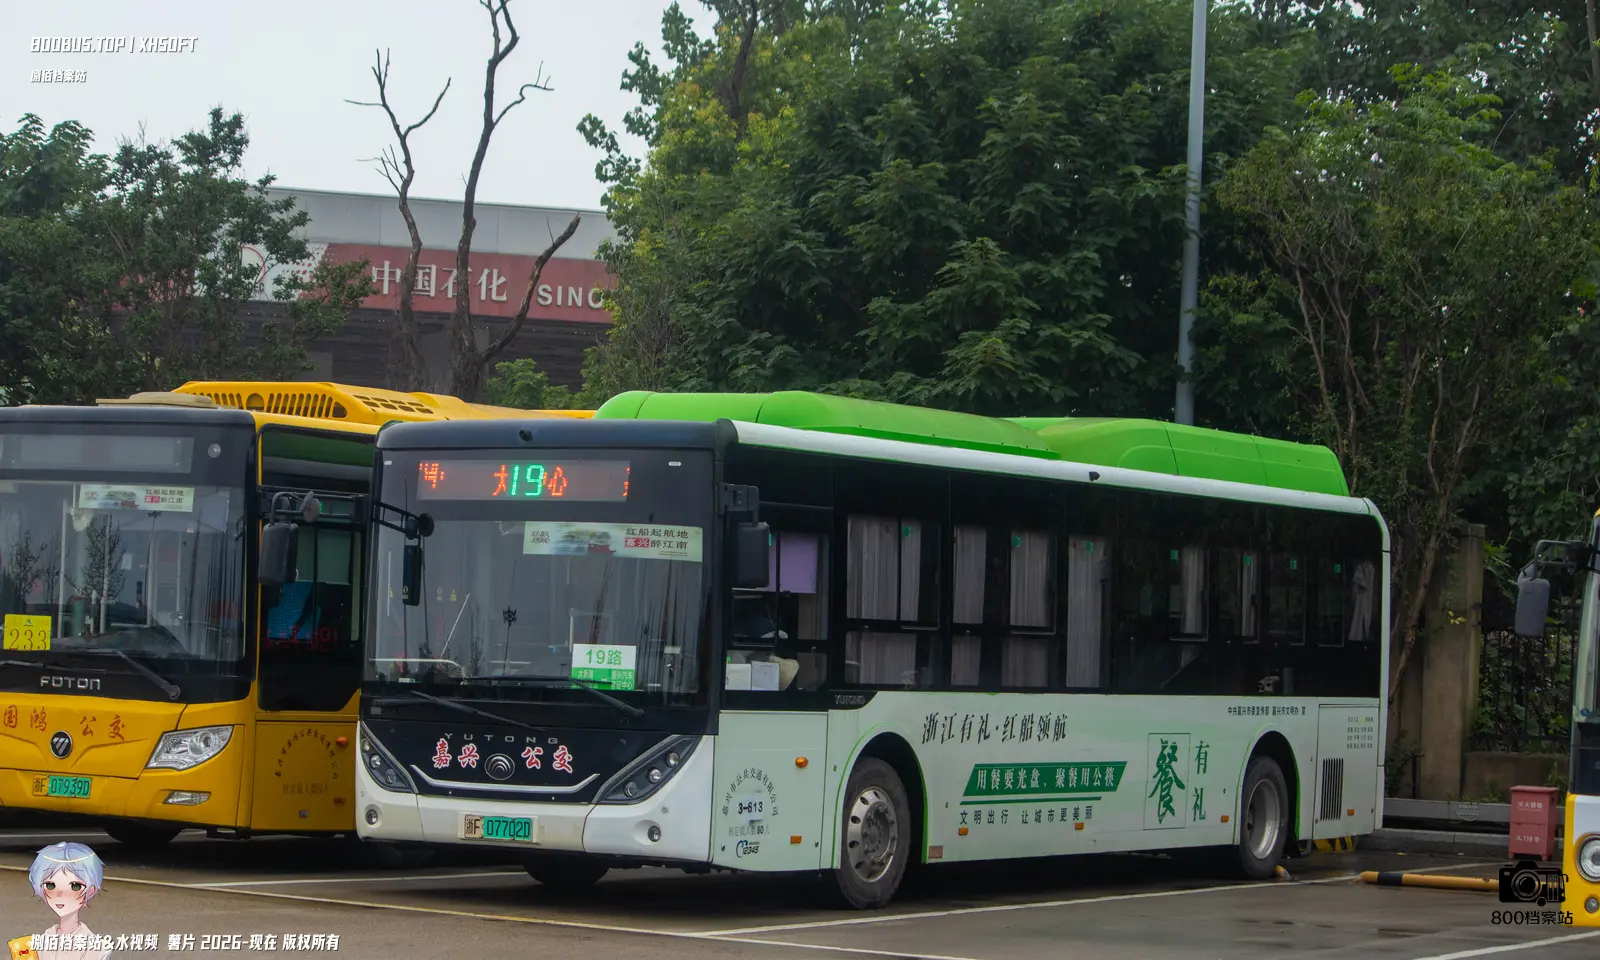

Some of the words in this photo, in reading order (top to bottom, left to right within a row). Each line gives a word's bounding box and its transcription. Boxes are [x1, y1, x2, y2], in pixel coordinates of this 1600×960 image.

[372, 260, 508, 301] 中国石化
[625, 527, 689, 539] 红船起航地
[624, 538, 688, 549] 嘉兴醉江南
[10, 628, 47, 651] 233
[586, 649, 622, 665] 19路
[40, 675, 101, 691] FOTON
[79, 714, 125, 741] 公交
[444, 733, 558, 745] YUTONG
[432, 737, 480, 769] 嘉兴
[521, 745, 573, 774] 公交
[737, 801, 764, 815] 3-613
[960, 808, 1009, 825] 文明出行
[1021, 805, 1093, 824] 让城市更美丽
